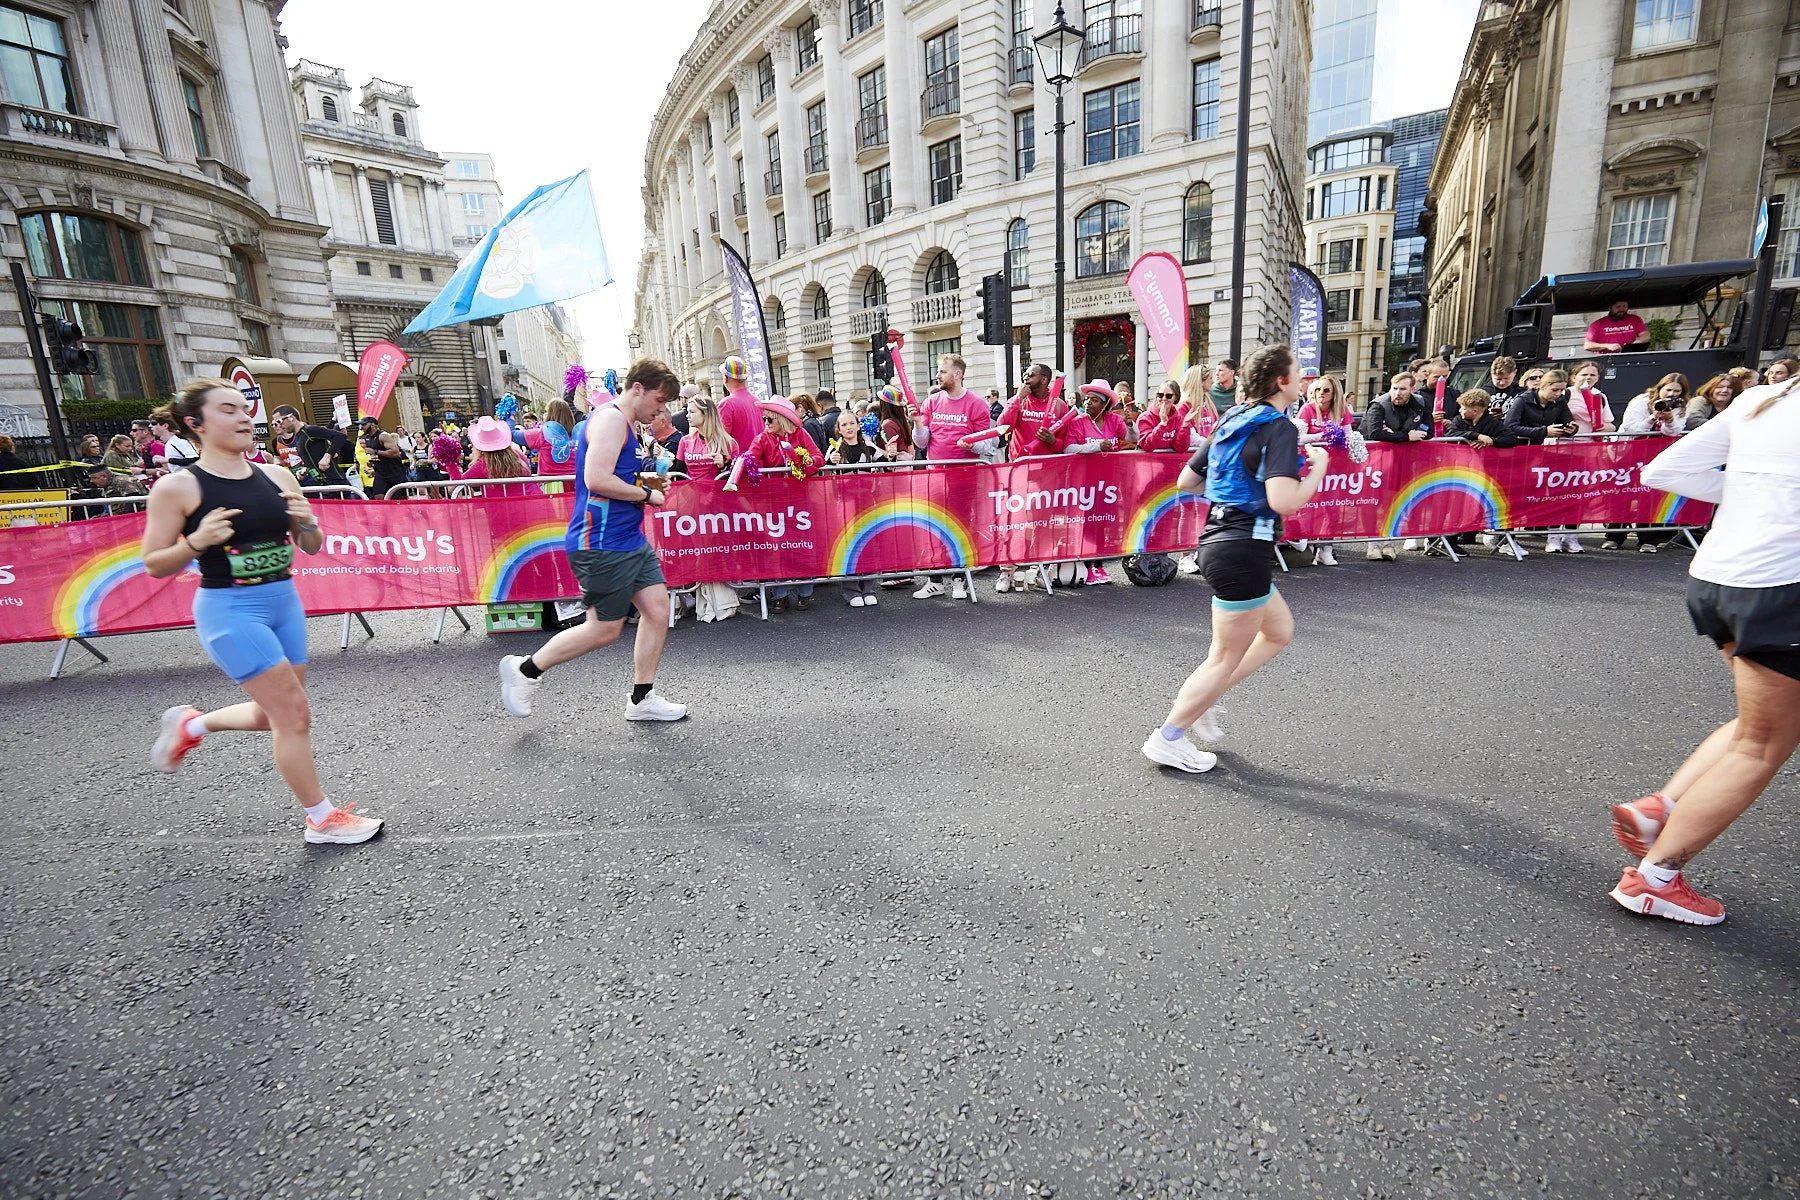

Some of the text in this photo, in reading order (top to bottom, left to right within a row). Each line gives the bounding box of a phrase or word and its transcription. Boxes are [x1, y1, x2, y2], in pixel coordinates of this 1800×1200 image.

[1071, 290, 1132, 304] LOMBARD STRE
[364, 353, 392, 400] Tommy's
[932, 412, 968, 422] Tommy's
[1316, 466, 1383, 495] my's
[1531, 462, 1647, 488] Tommy'
[988, 480, 1118, 515] Tommy's
[1583, 490, 1602, 498] and
[1621, 486, 1652, 494] charity
[1320, 498, 1335, 507] and
[1335, 497, 1355, 507] baby
[1355, 497, 1379, 506] charity
[653, 506, 812, 538] Tommy's
[1004, 519, 1048, 532] pregnancy
[1049, 514, 1065, 525] and
[1066, 514, 1086, 525] baby
[1087, 513, 1116, 522] charity
[319, 530, 455, 561] mmy's
[658, 540, 813, 557] The pregnancy and baby charity
[302, 566, 362, 577] pregnancy
[365, 564, 387, 574] and
[389, 564, 419, 575] baby
[422, 564, 461, 575] charity
